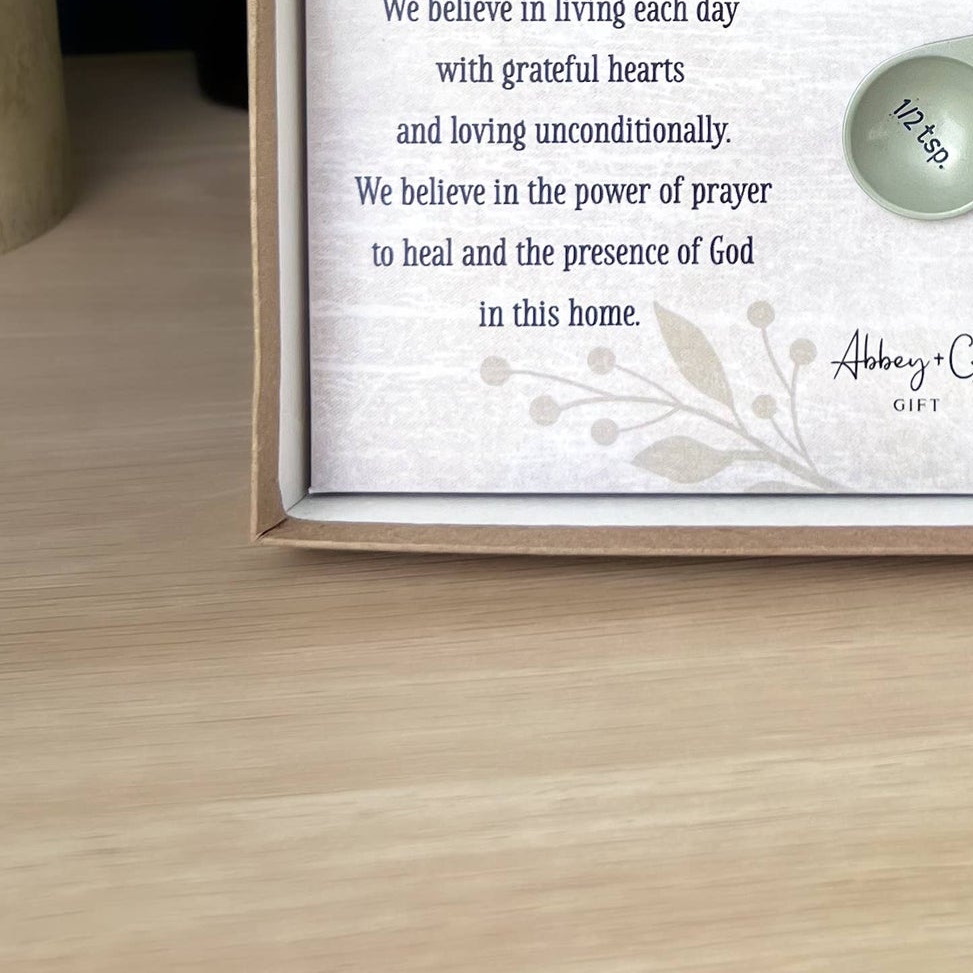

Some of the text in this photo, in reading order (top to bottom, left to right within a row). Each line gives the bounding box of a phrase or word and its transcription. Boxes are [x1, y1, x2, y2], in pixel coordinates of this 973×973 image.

[436, 54, 685, 89] with grateful hearts
[396, 114, 731, 150] and loving unconditionally.
[892, 98, 949, 169] 1/2 tsp.
[355, 176, 773, 210] We believe in the power of prayer
[372, 236, 755, 271] to heal and the presence of God
[479, 299, 640, 328] in this home.
[830, 328, 930, 392] Abbey
[893, 398, 940, 412] GIFT
